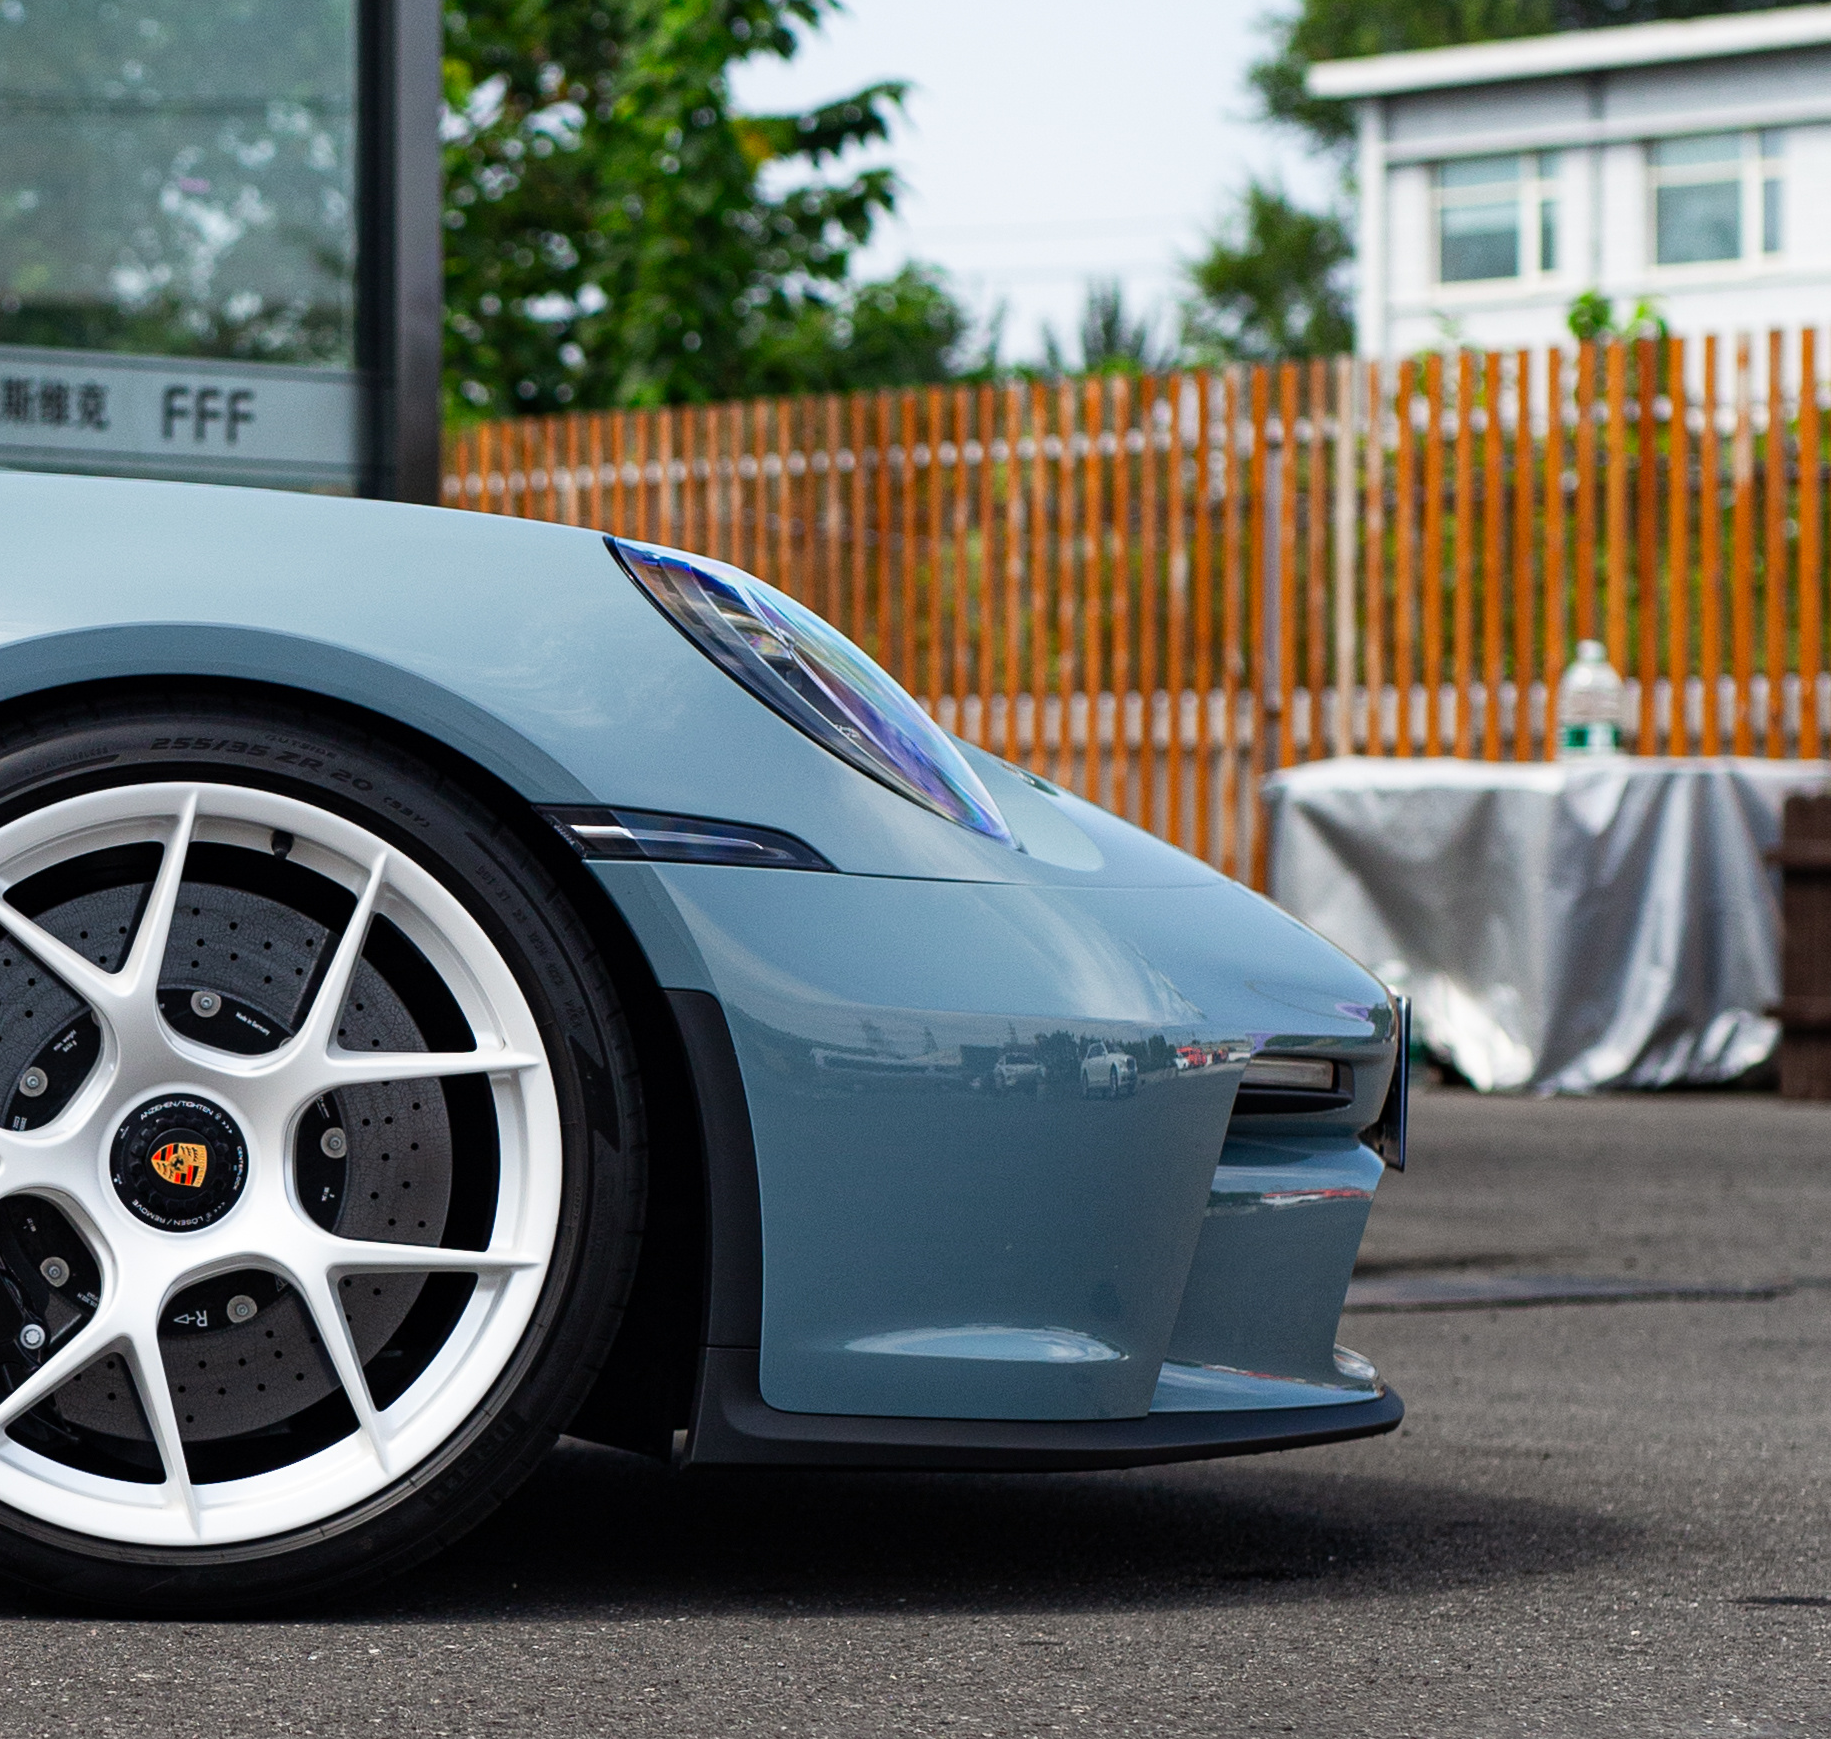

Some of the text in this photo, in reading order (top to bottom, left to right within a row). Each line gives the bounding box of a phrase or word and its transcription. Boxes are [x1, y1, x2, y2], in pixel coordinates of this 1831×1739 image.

[161, 384, 255, 445] FFF
[149, 736, 269, 758] 255/35
[274, 747, 324, 773] ZR
[329, 765, 375, 795] 20
[130, 1198, 166, 1224] REMOVE
[195, 1309, 208, 1327] R
[421, 1408, 531, 1518] PIRELLI
